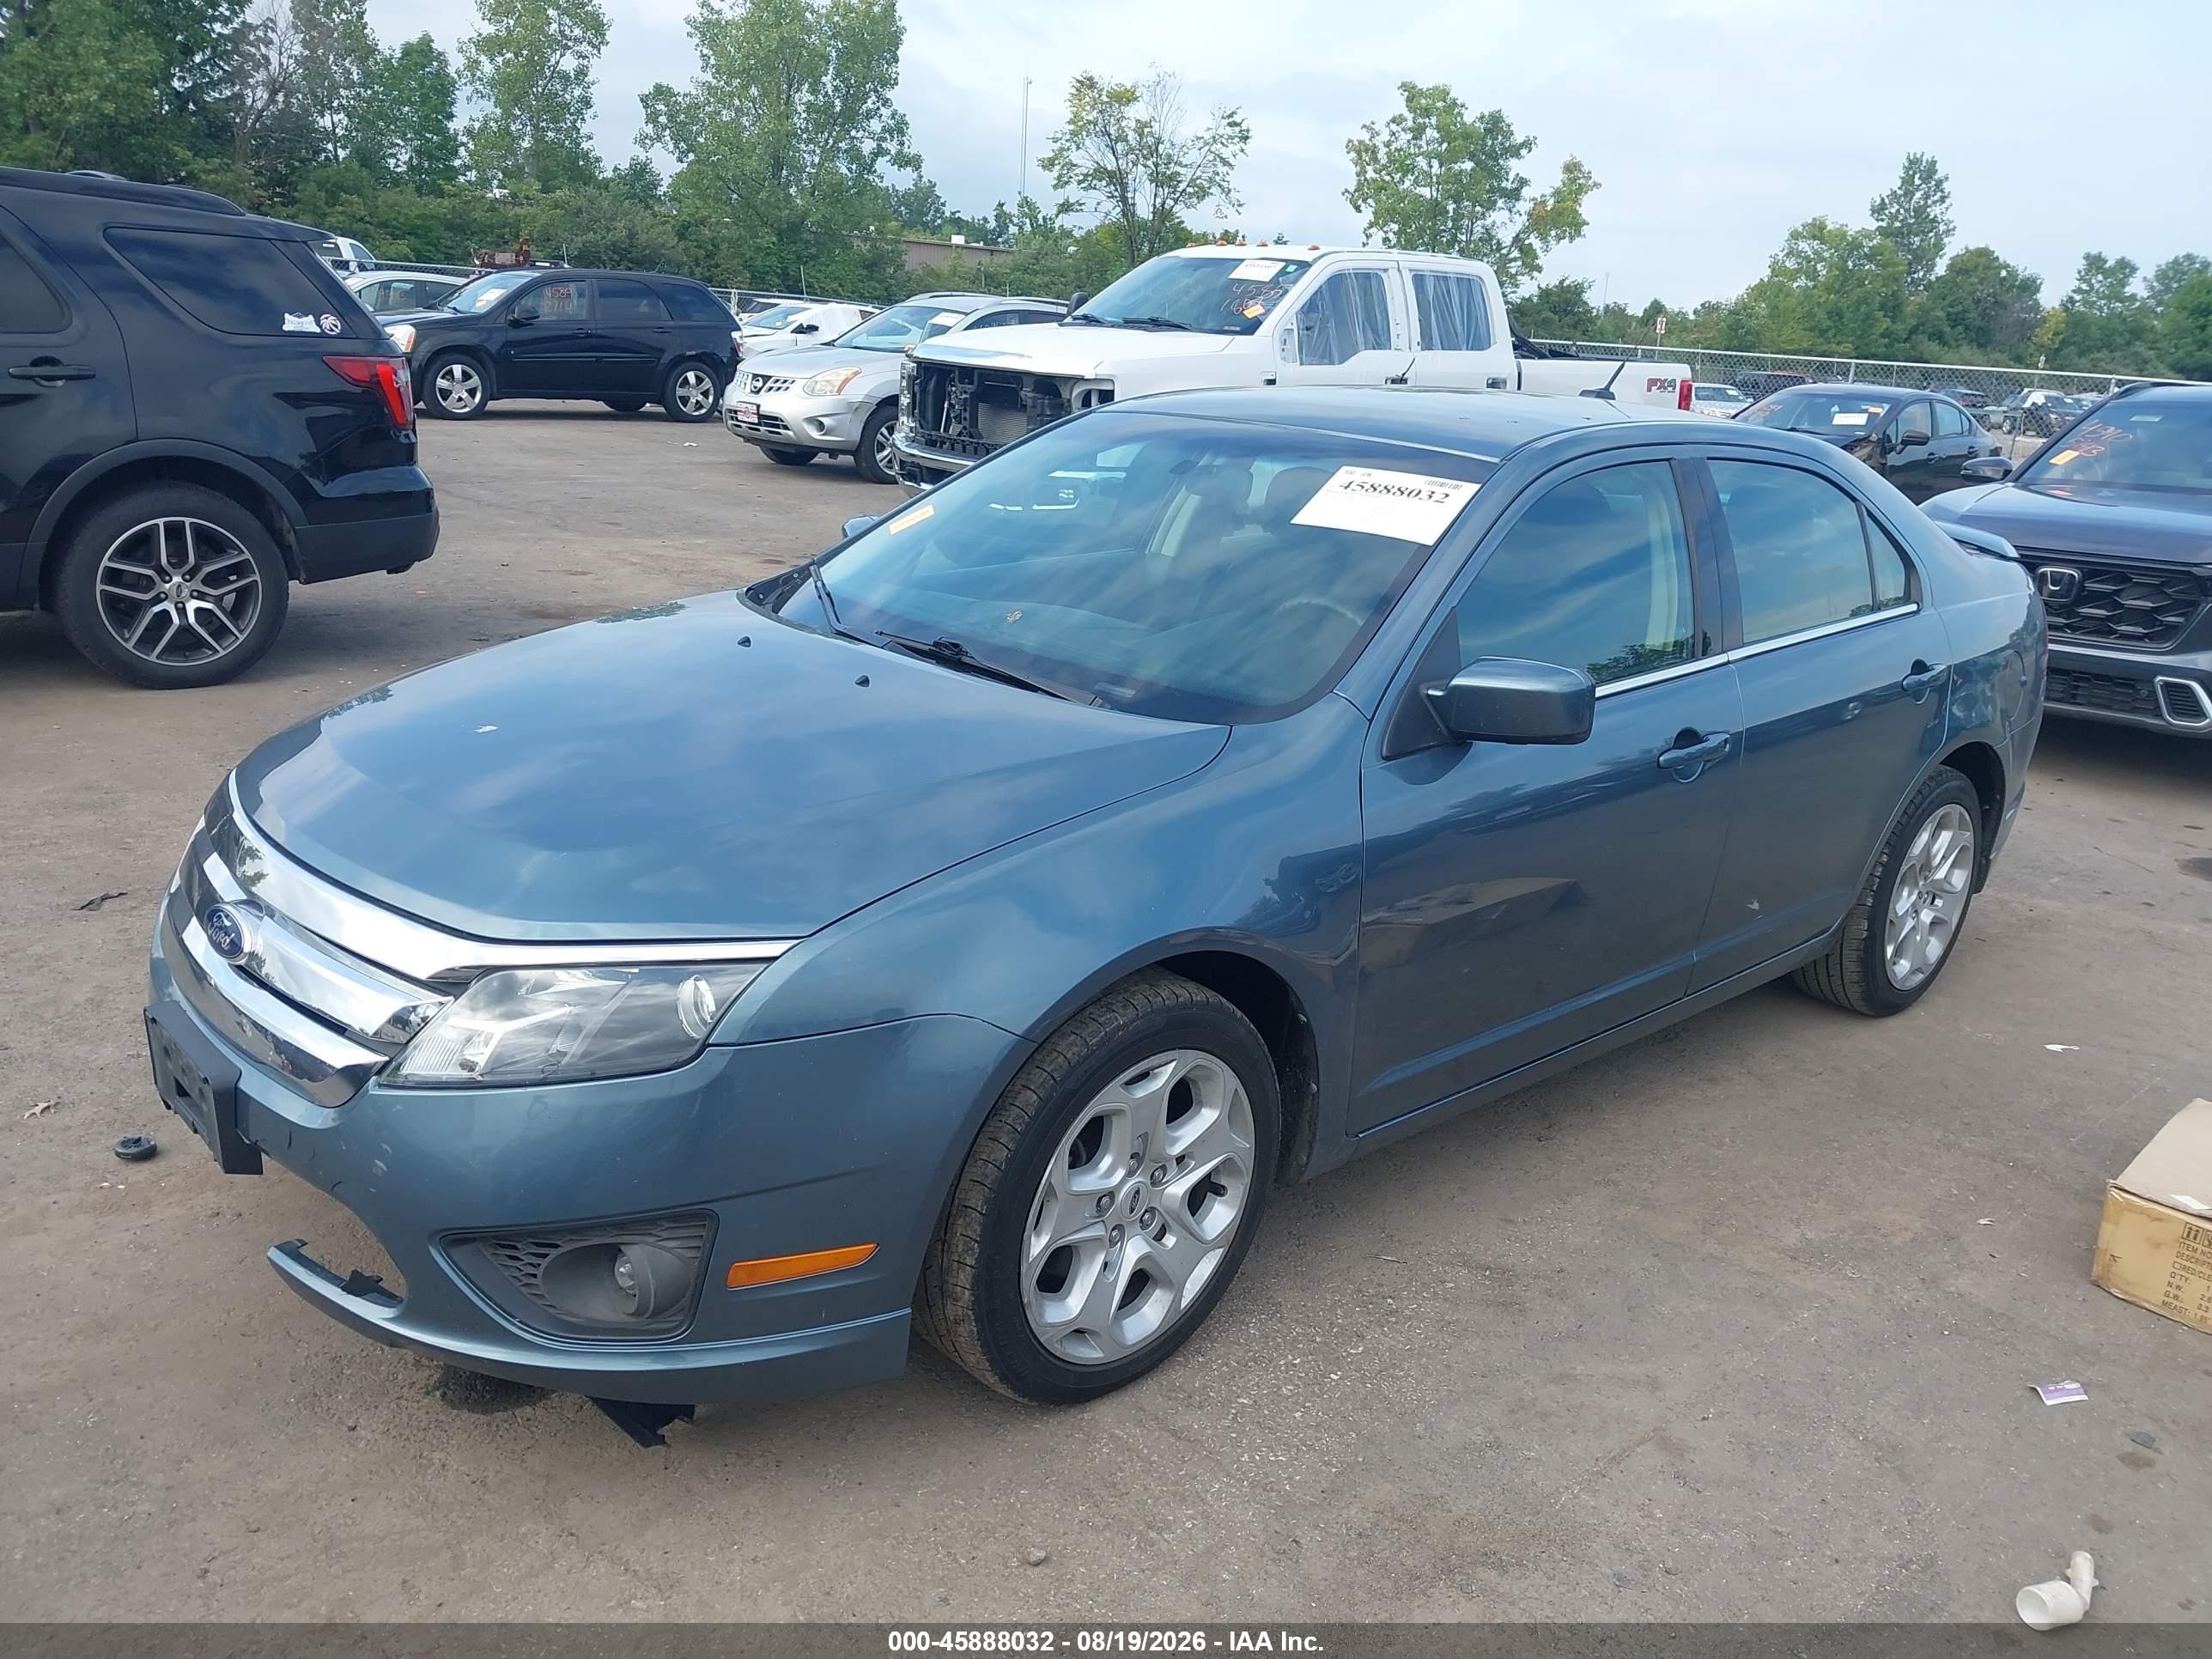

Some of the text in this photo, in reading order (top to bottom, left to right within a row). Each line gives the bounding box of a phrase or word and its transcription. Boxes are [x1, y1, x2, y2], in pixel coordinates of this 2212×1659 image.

[1647, 378, 1676, 392] FX4
[1339, 479, 1449, 504] 45888032
[207, 912, 235, 951] Ford
[2179, 1241, 2198, 1253] ITEM
